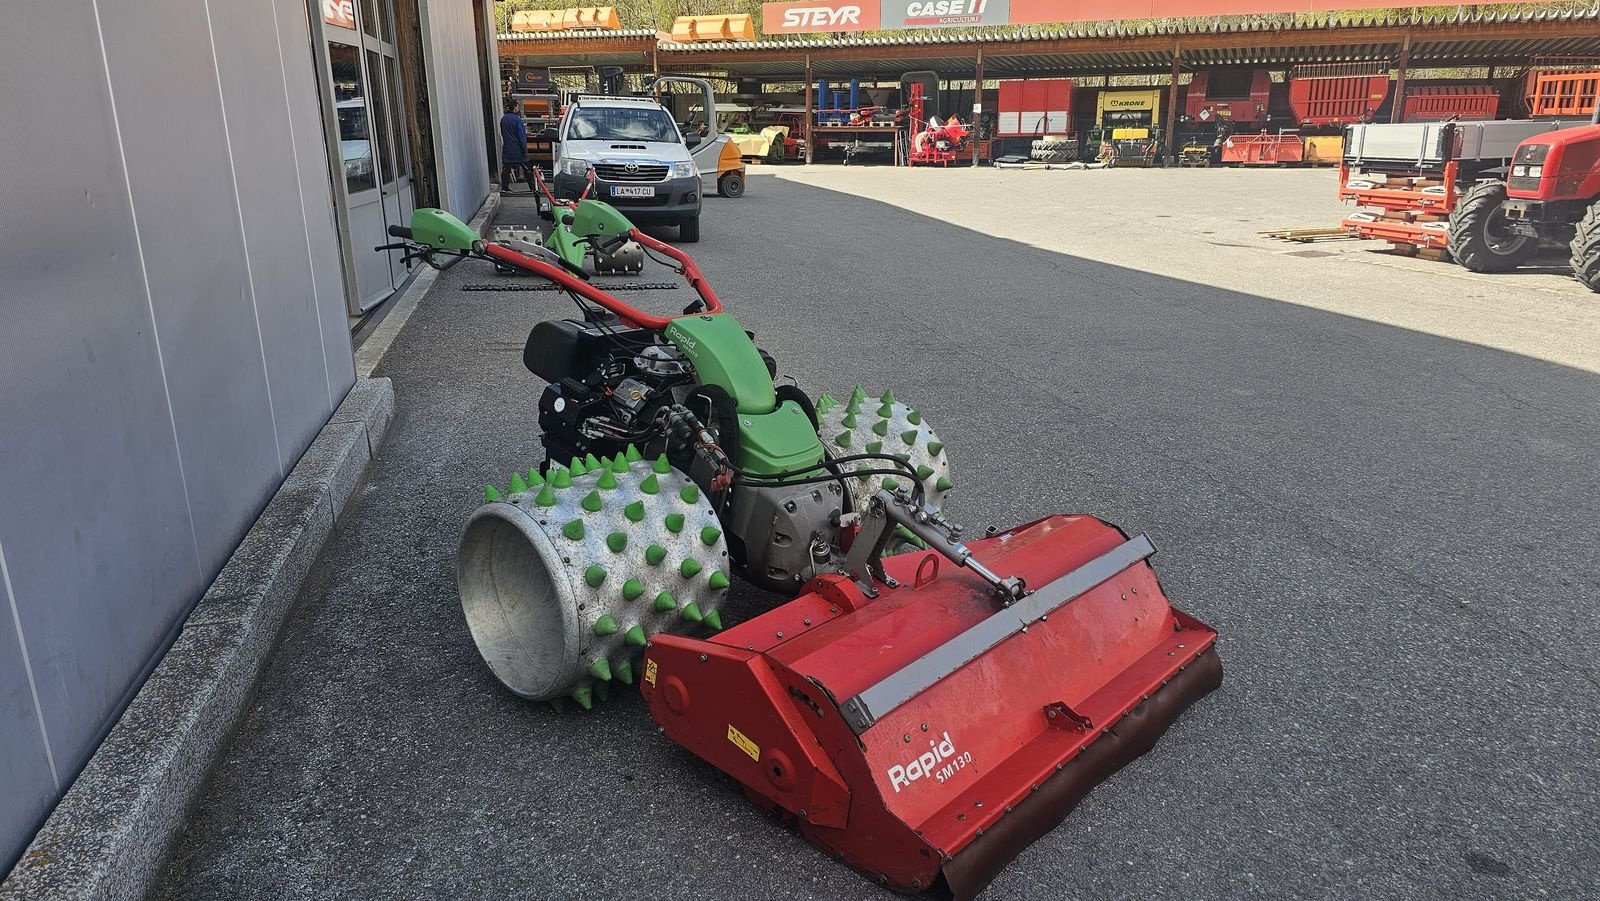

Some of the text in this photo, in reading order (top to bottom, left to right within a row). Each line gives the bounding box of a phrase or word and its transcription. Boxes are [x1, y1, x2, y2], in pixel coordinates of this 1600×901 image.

[782, 6, 861, 27] STEYR
[907, 1, 964, 16] CASE
[670, 326, 696, 349] Rapid
[888, 731, 955, 793] Rapid
